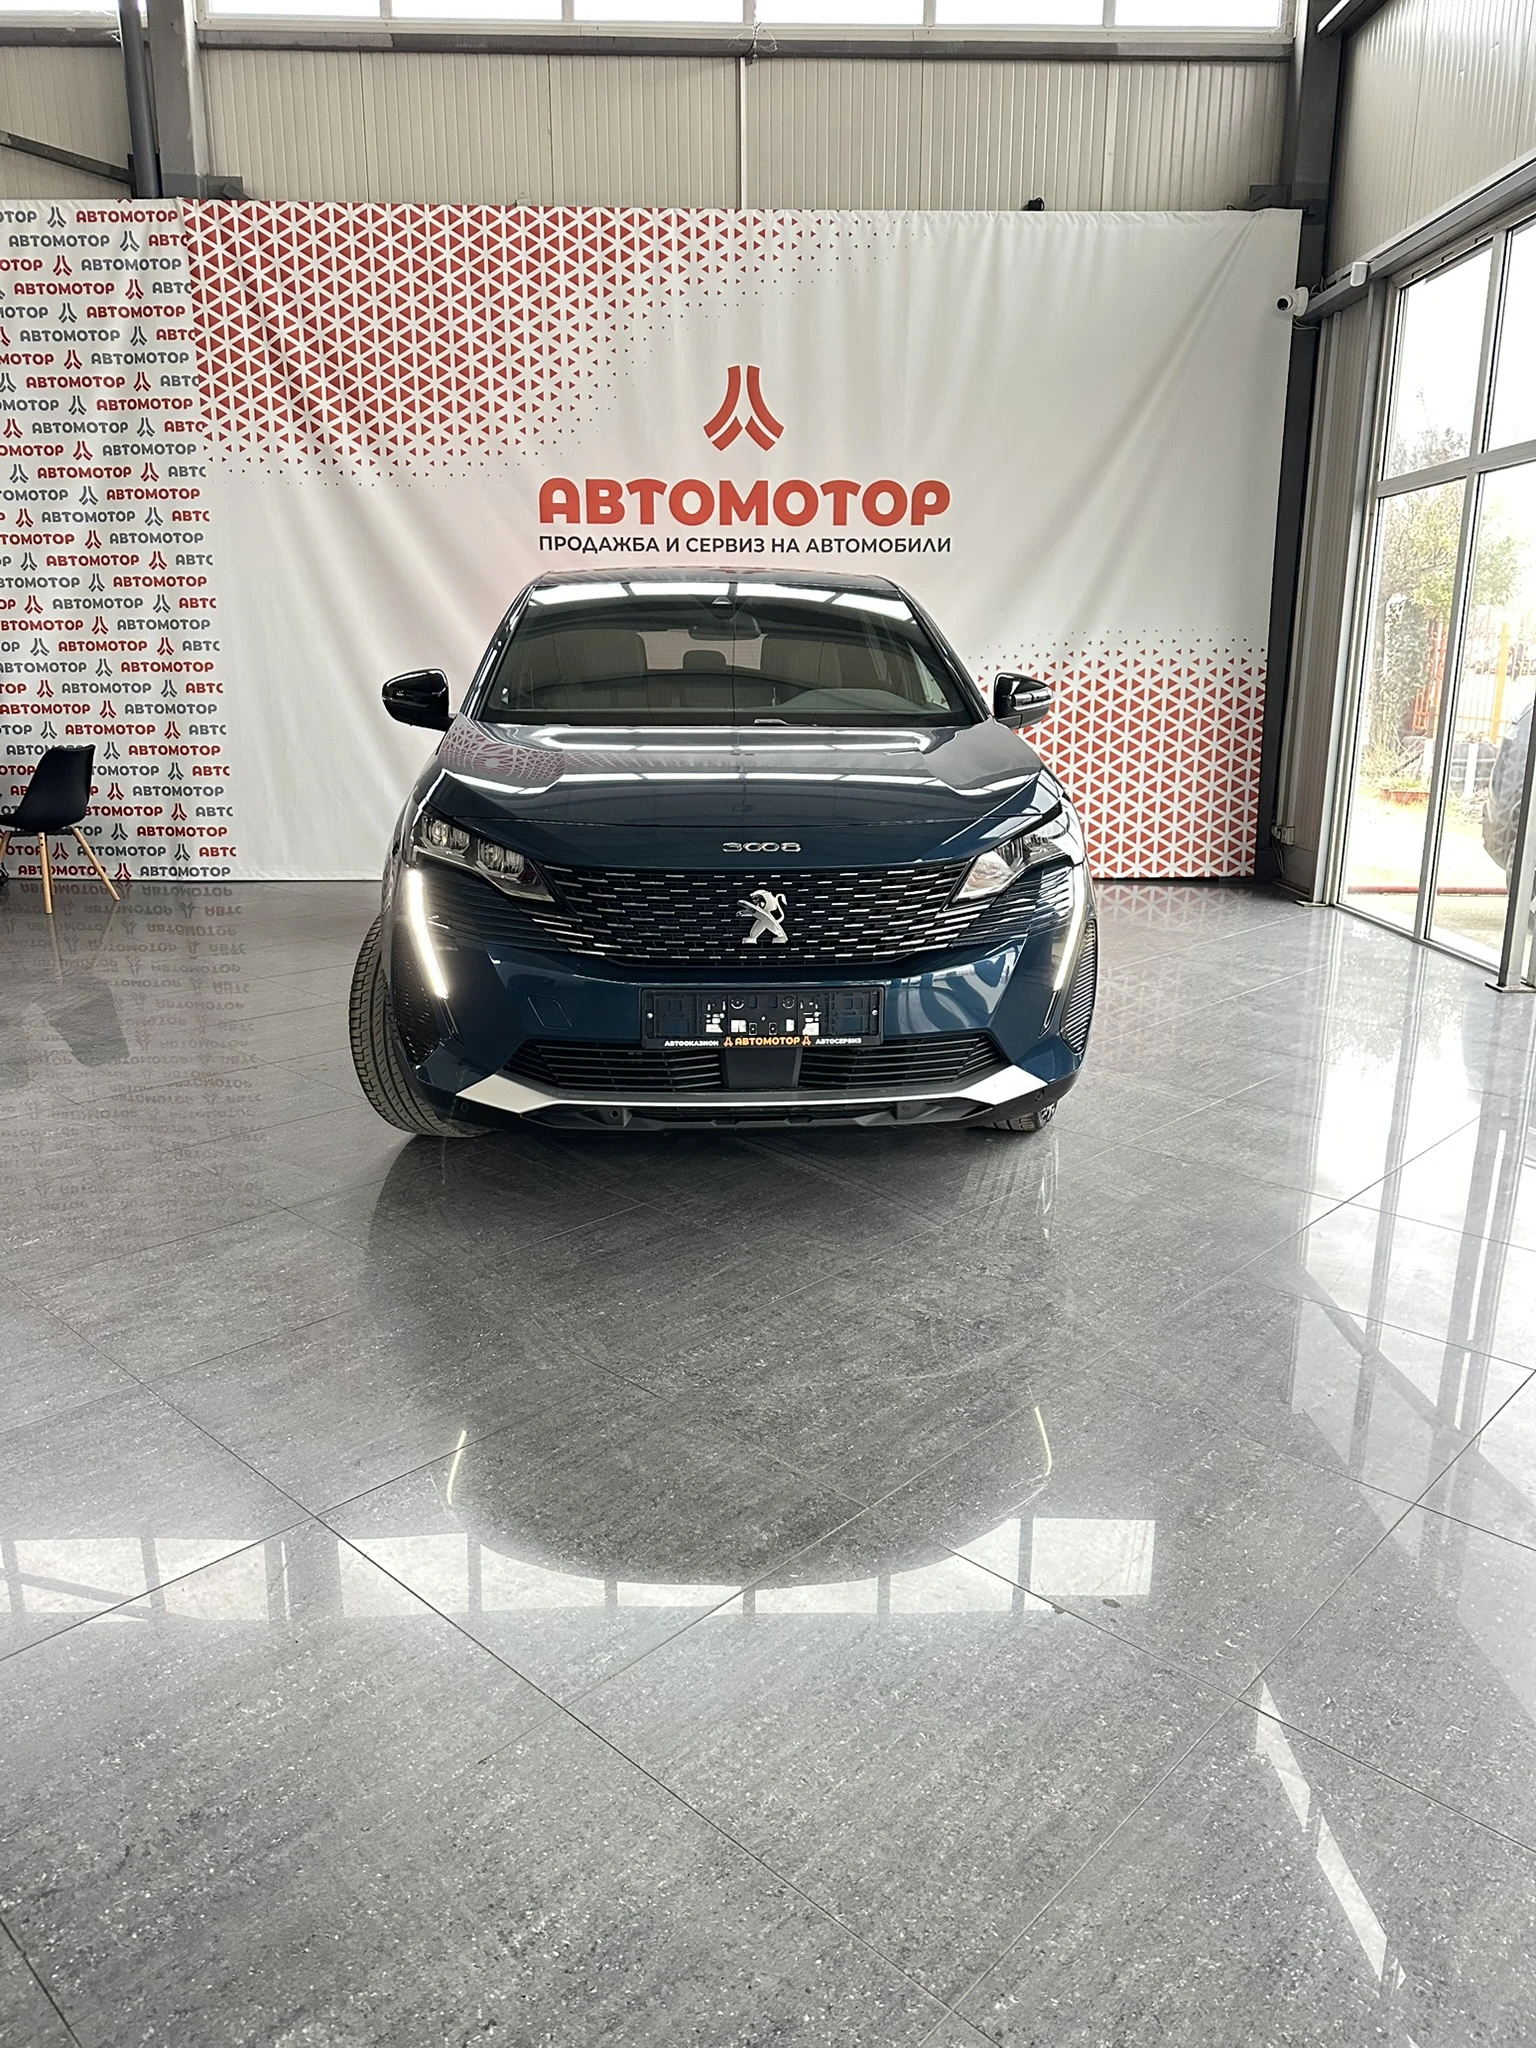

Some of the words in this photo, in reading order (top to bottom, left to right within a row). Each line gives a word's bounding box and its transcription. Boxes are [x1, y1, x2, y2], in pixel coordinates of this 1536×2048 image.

[76, 210, 178, 223] АВТОМОТОР
[9, 235, 110, 248] АВТОМОТОР
[81, 258, 182, 271] АВТОМОТОР
[14, 282, 114, 295] АВТОМОТОР
[0, 306, 48, 318] ОТОР
[86, 305, 186, 318] АВТОМОТОР
[20, 329, 120, 342] АВТОМОТОР
[91, 352, 189, 365] АВТОМОТОР
[26, 376, 125, 388] АВТОМОТОР
[0, 399, 59, 411] МОТОР
[96, 398, 193, 411] АВТОМОТОР
[32, 422, 128, 434] АВТОМОТОР
[102, 444, 196, 456] АВТОМОТОР
[37, 466, 132, 479] АВТОМОТОР
[0, 489, 68, 501] ОМОТОР
[106, 488, 200, 500] АВТОМОТОР
[539, 477, 951, 527] АВТОМОТОР
[42, 511, 135, 522] АВТОМОТОР
[110, 532, 204, 544] АВТОМОТОР
[539, 535, 659, 554] ПРОДАЖБА
[666, 537, 680, 553] И
[685, 537, 765, 553] СЕРВИЗ
[771, 538, 801, 553] НА
[806, 537, 951, 554] АВТОМОБИЛИ
[46, 554, 139, 566] АВТОМОТОР
[113, 576, 207, 588] АВТОМОТОР
[52, 598, 143, 609] АВТОМОТОР
[117, 619, 210, 630] АВТОМОТОР
[58, 640, 147, 652] АВТОМОТОР
[121, 662, 214, 672] АВТОМОТОР
[62, 683, 152, 694] АВТОМОТОР
[0, 704, 90, 715] АВТОМОТОР
[125, 704, 217, 714] АВТОМОТОР
[0, 724, 32, 735] ТОР
[65, 724, 156, 735] АВТОМОТОР
[128, 744, 220, 756] АВТОМОТОР
[133, 786, 224, 796] АВТОМОТОР
[137, 826, 228, 838] АВТОМОТОР
[722, 842, 801, 853] 3008
[140, 866, 231, 877] АВТОМОТОР
[734, 1036, 801, 1047] АВТОМОТОР
[815, 1037, 862, 1045] АВТОСЕРВИЗ
